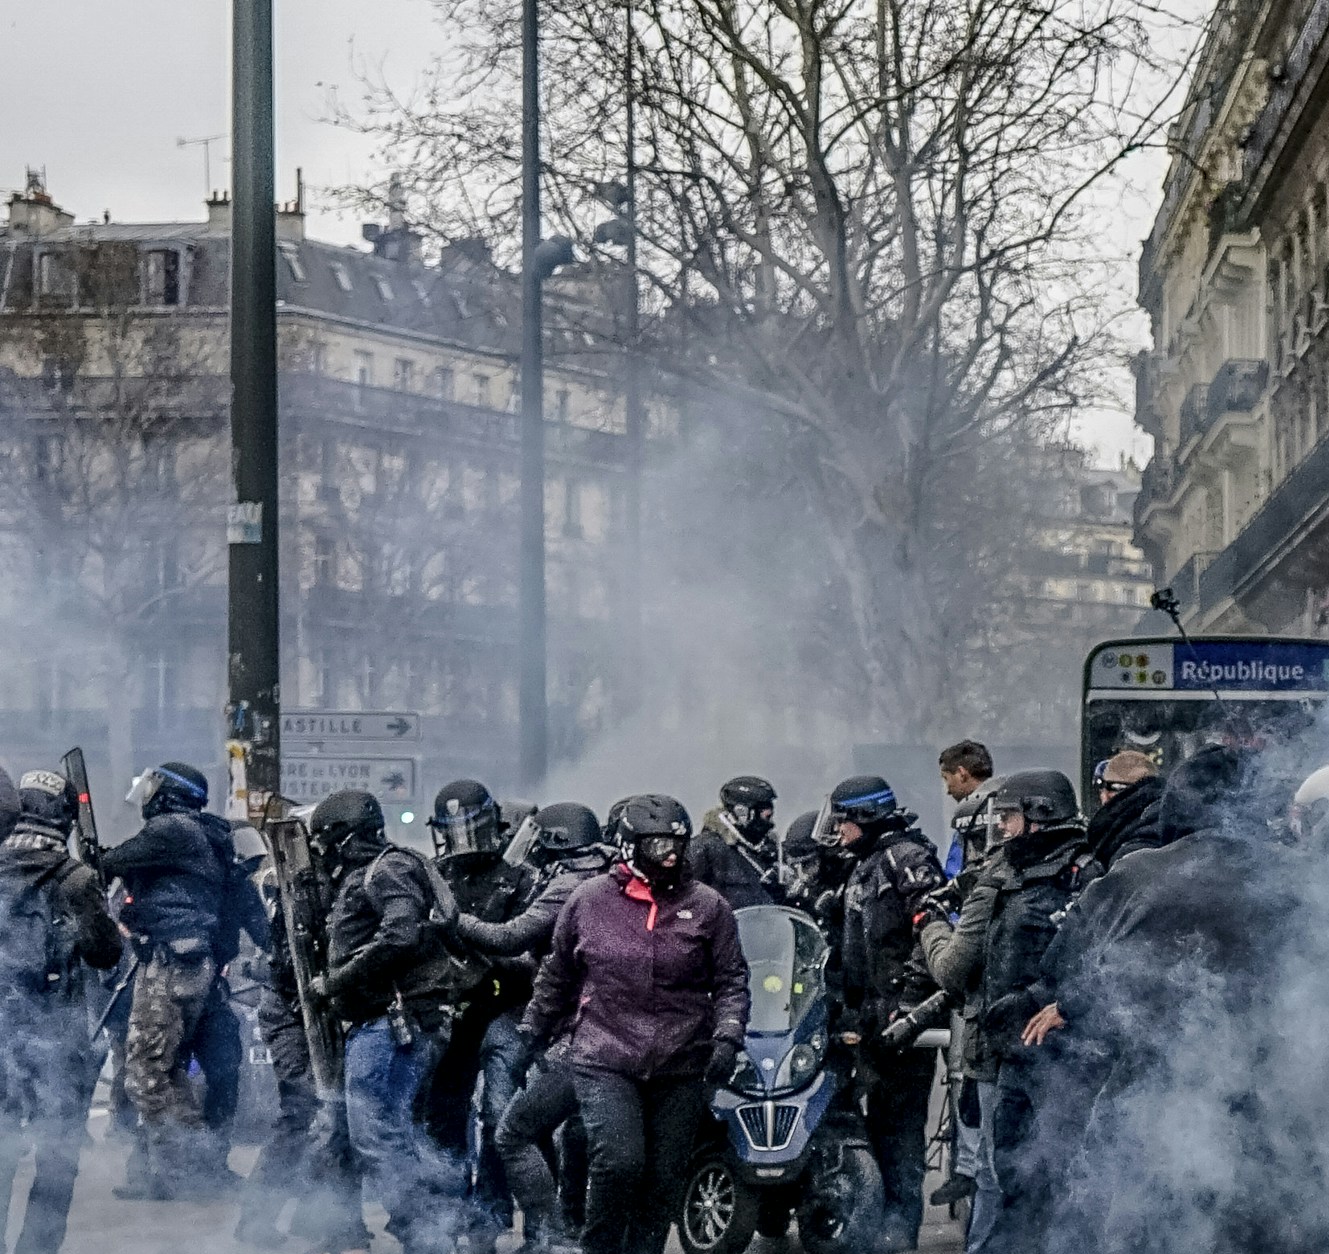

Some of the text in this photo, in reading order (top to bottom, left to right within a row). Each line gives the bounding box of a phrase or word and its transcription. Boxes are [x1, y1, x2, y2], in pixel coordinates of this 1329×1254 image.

[1182, 660, 1304, 684] République
[283, 718, 361, 733] ASTILLE
[329, 765, 370, 777] LYON
